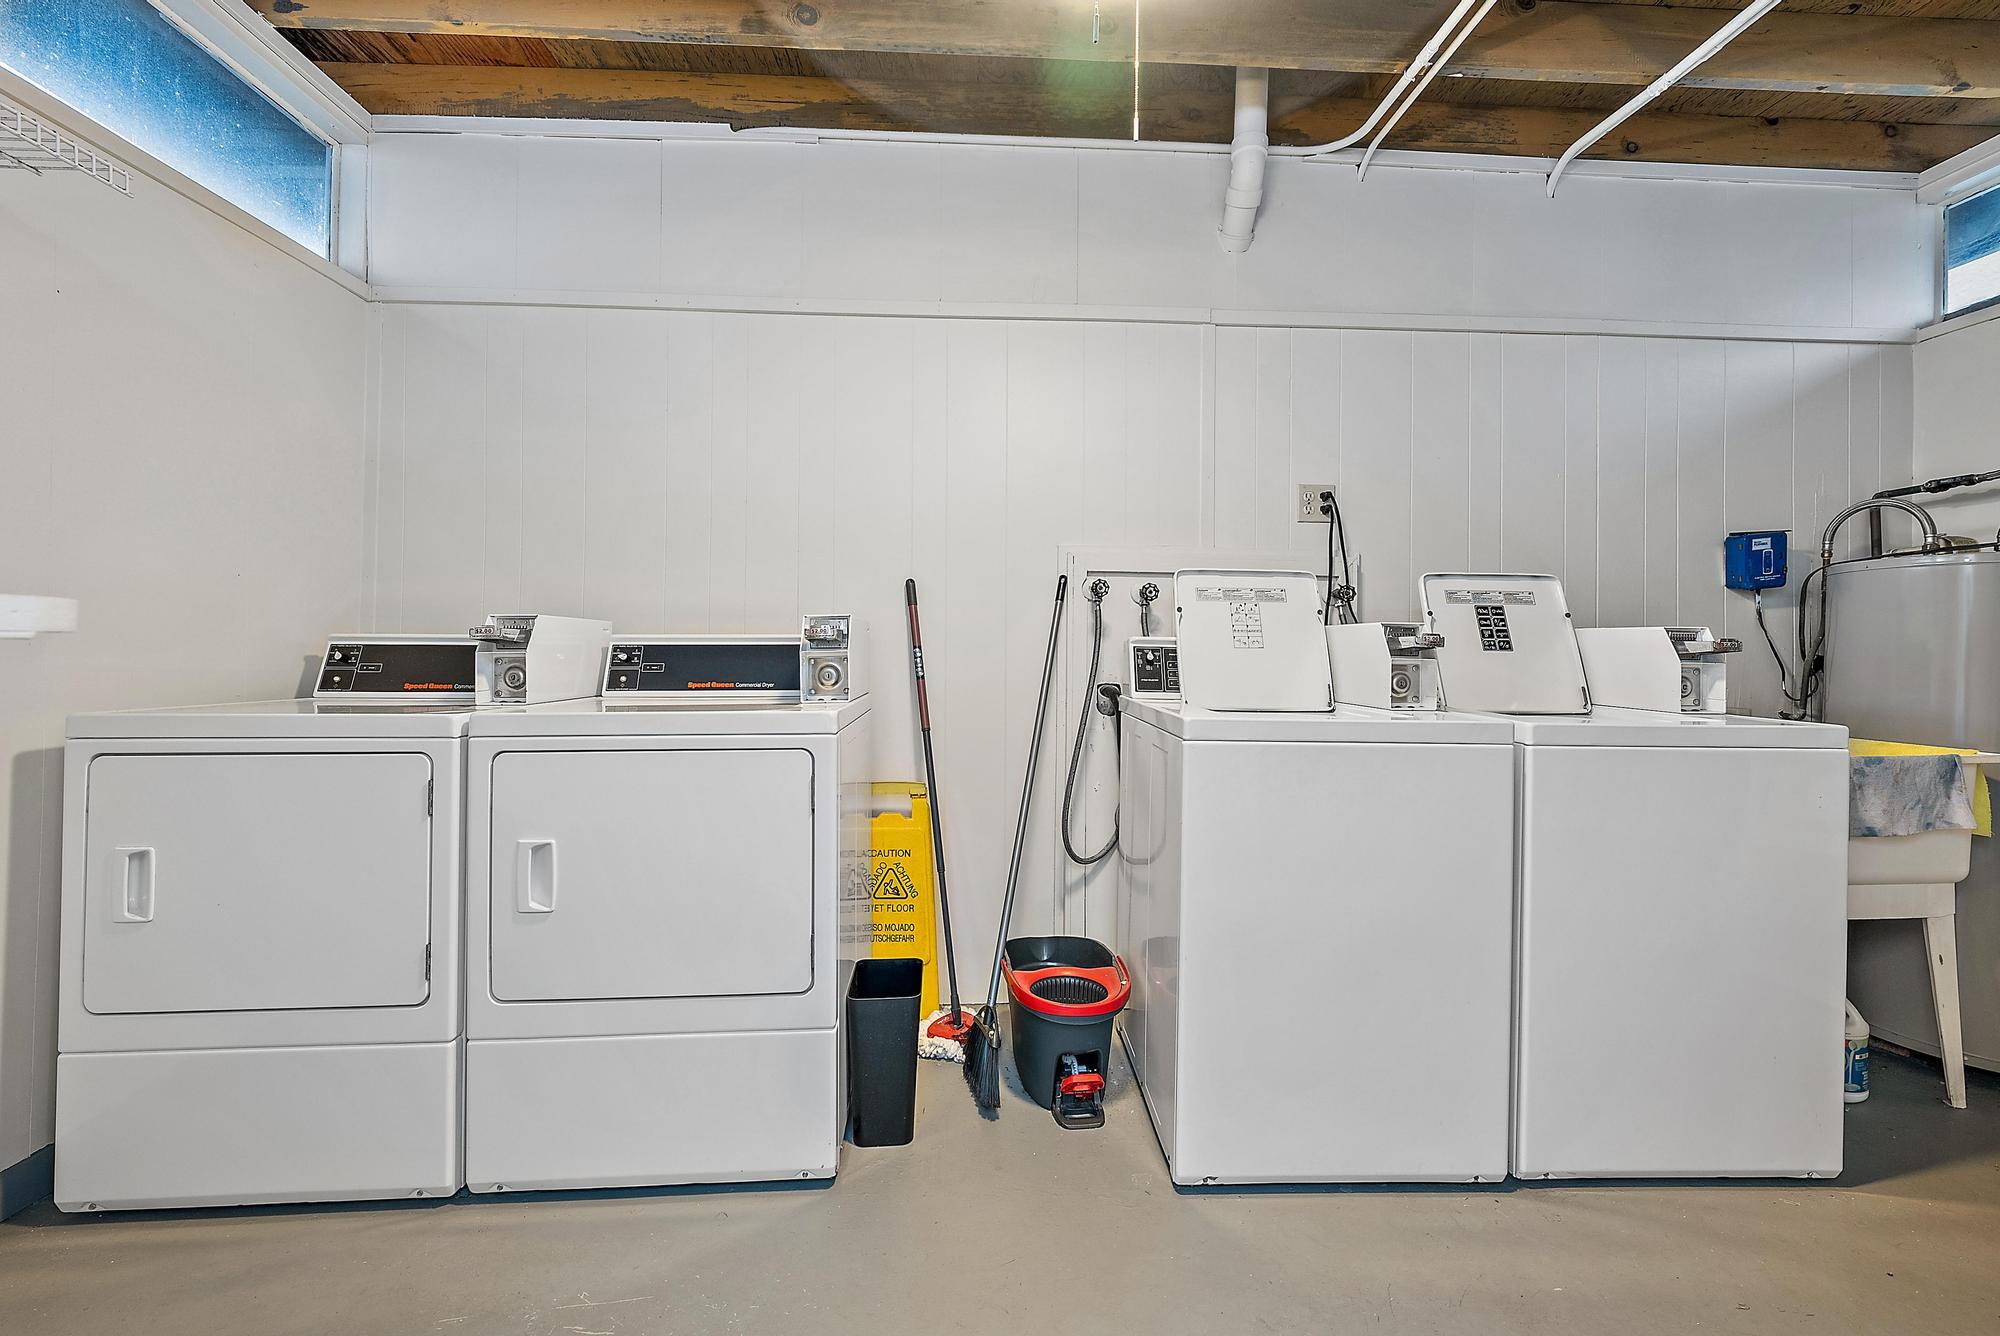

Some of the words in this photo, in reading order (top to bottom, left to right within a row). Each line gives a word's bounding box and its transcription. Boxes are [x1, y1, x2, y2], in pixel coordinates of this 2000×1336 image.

[871, 849, 911, 857] CAUTION
[893, 862, 918, 899] ACHTUNG
[887, 904, 915, 912] FLOOR
[885, 924, 915, 932] MOJADO
[871, 934, 915, 942] UTSCHGEFAHR
